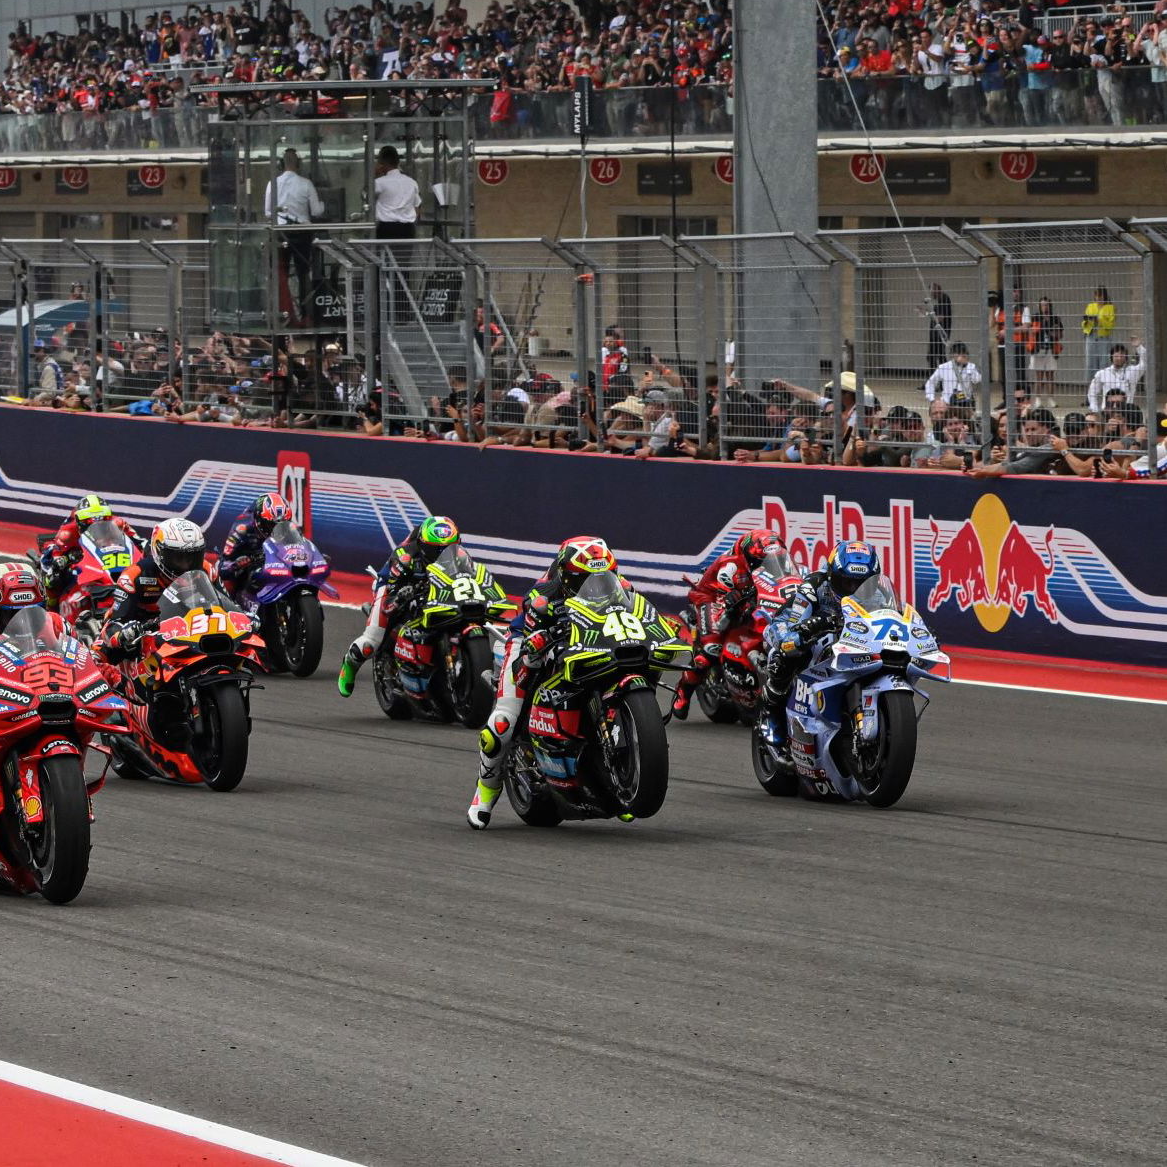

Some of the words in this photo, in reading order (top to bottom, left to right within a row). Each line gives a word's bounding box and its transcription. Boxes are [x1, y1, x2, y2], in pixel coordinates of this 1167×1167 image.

[485, 162, 502, 180] 25
[598, 161, 614, 179] 26
[724, 158, 734, 176] 2
[858, 155, 875, 176] 28
[1009, 154, 1027, 175] 29
[70, 170, 83, 184] 22
[145, 168, 160, 183] 23
[102, 553, 131, 570] 36
[451, 577, 486, 602] 21
[605, 605, 627, 614] ebay
[760, 599, 782, 609] Lenov
[191, 612, 228, 634] 37
[602, 611, 647, 642] 49
[871, 618, 910, 642] 73
[22, 663, 74, 689] 93
[80, 683, 109, 703] Lenovo
[794, 703, 808, 715] NEWS
